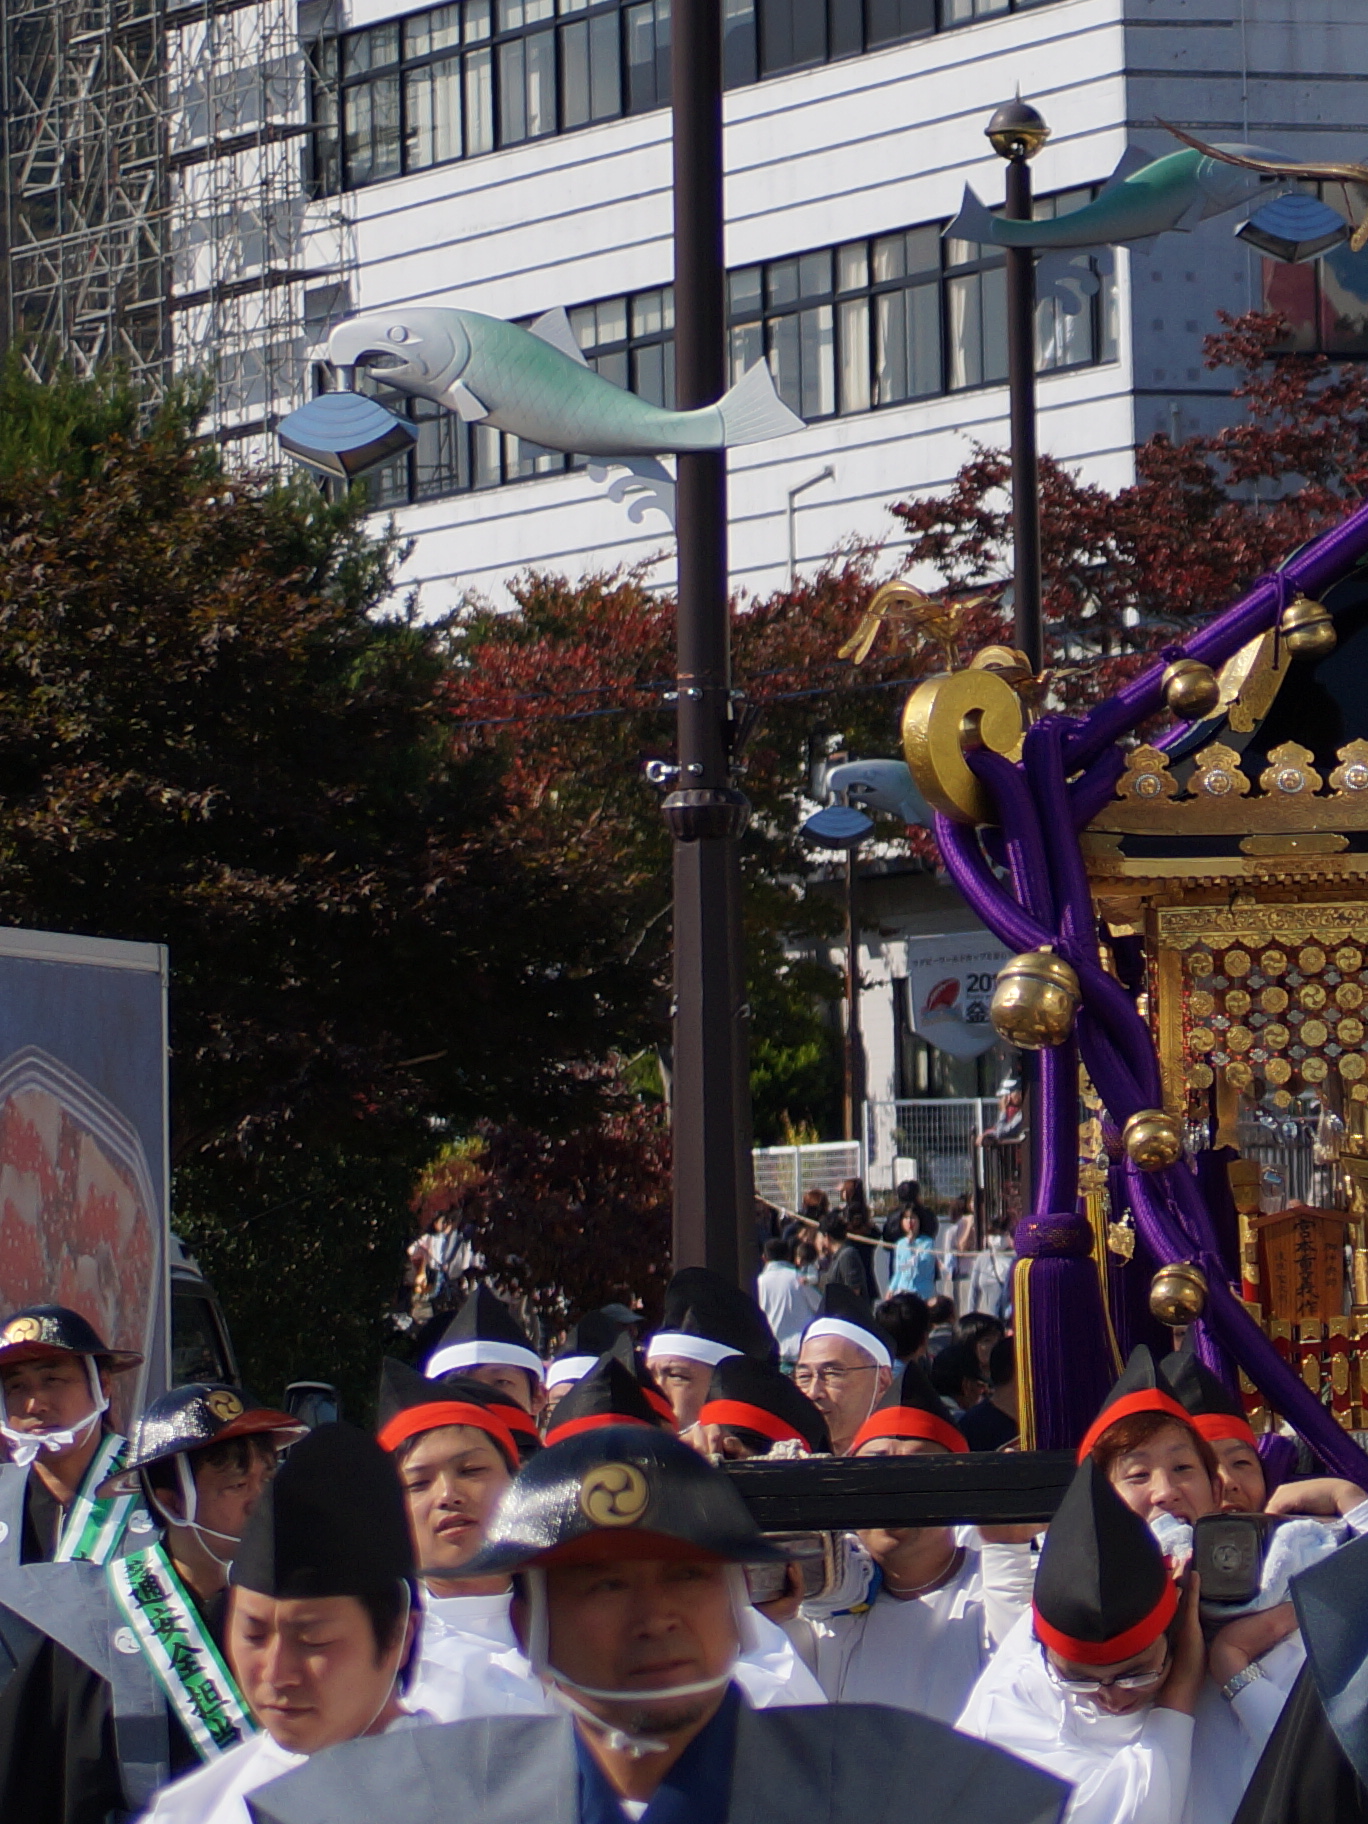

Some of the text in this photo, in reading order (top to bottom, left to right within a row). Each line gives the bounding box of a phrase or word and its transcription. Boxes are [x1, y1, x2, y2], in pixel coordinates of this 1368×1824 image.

[124, 1559, 243, 1747] 交通安全担当
